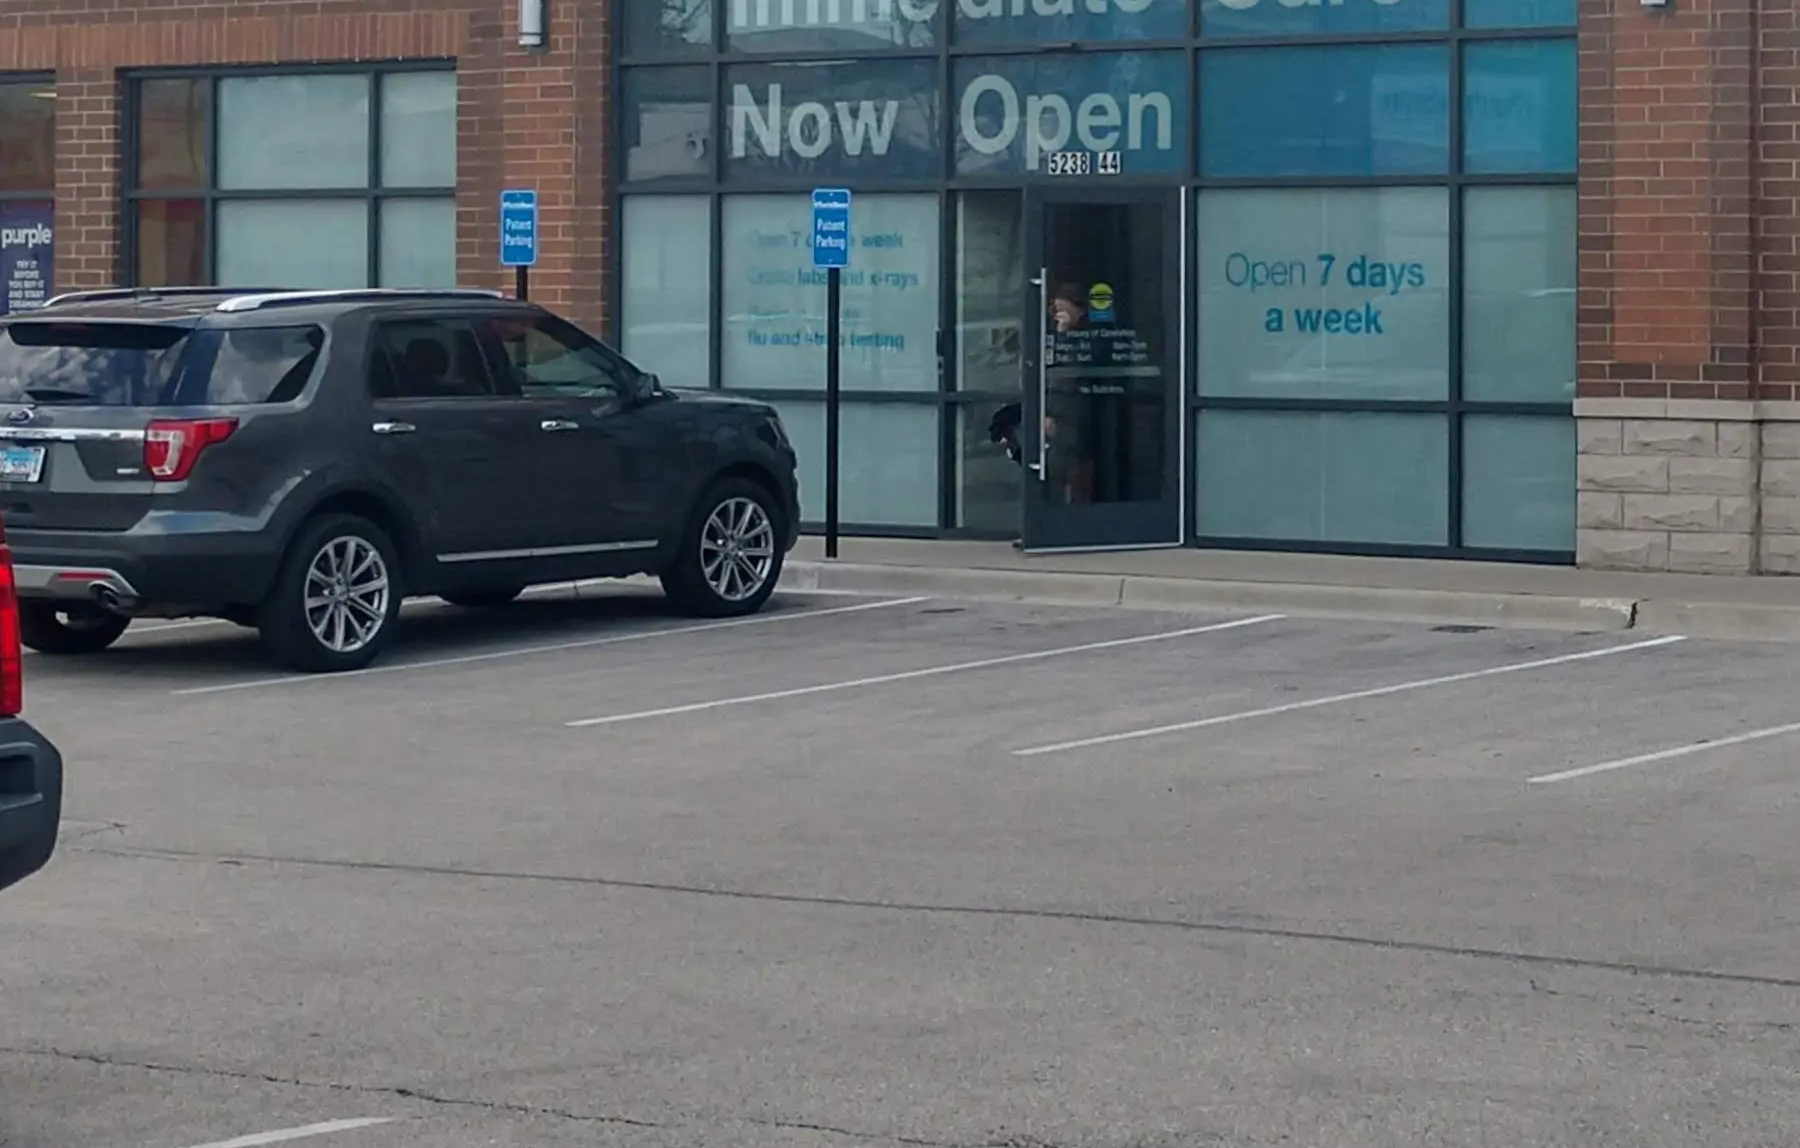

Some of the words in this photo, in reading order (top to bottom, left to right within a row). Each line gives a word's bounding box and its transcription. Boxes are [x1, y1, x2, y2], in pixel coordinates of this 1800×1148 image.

[731, 82, 899, 160] Now
[959, 73, 1173, 171] Open
[1049, 152, 1090, 173] 5238
[1100, 152, 1119, 172] 44
[1, 223, 52, 249] purple
[816, 234, 846, 251] Parking
[1225, 252, 1306, 292] Open
[1317, 254, 1336, 287] 7
[1346, 255, 1426, 296] days
[1264, 307, 1284, 333] a
[1294, 302, 1385, 334] week
